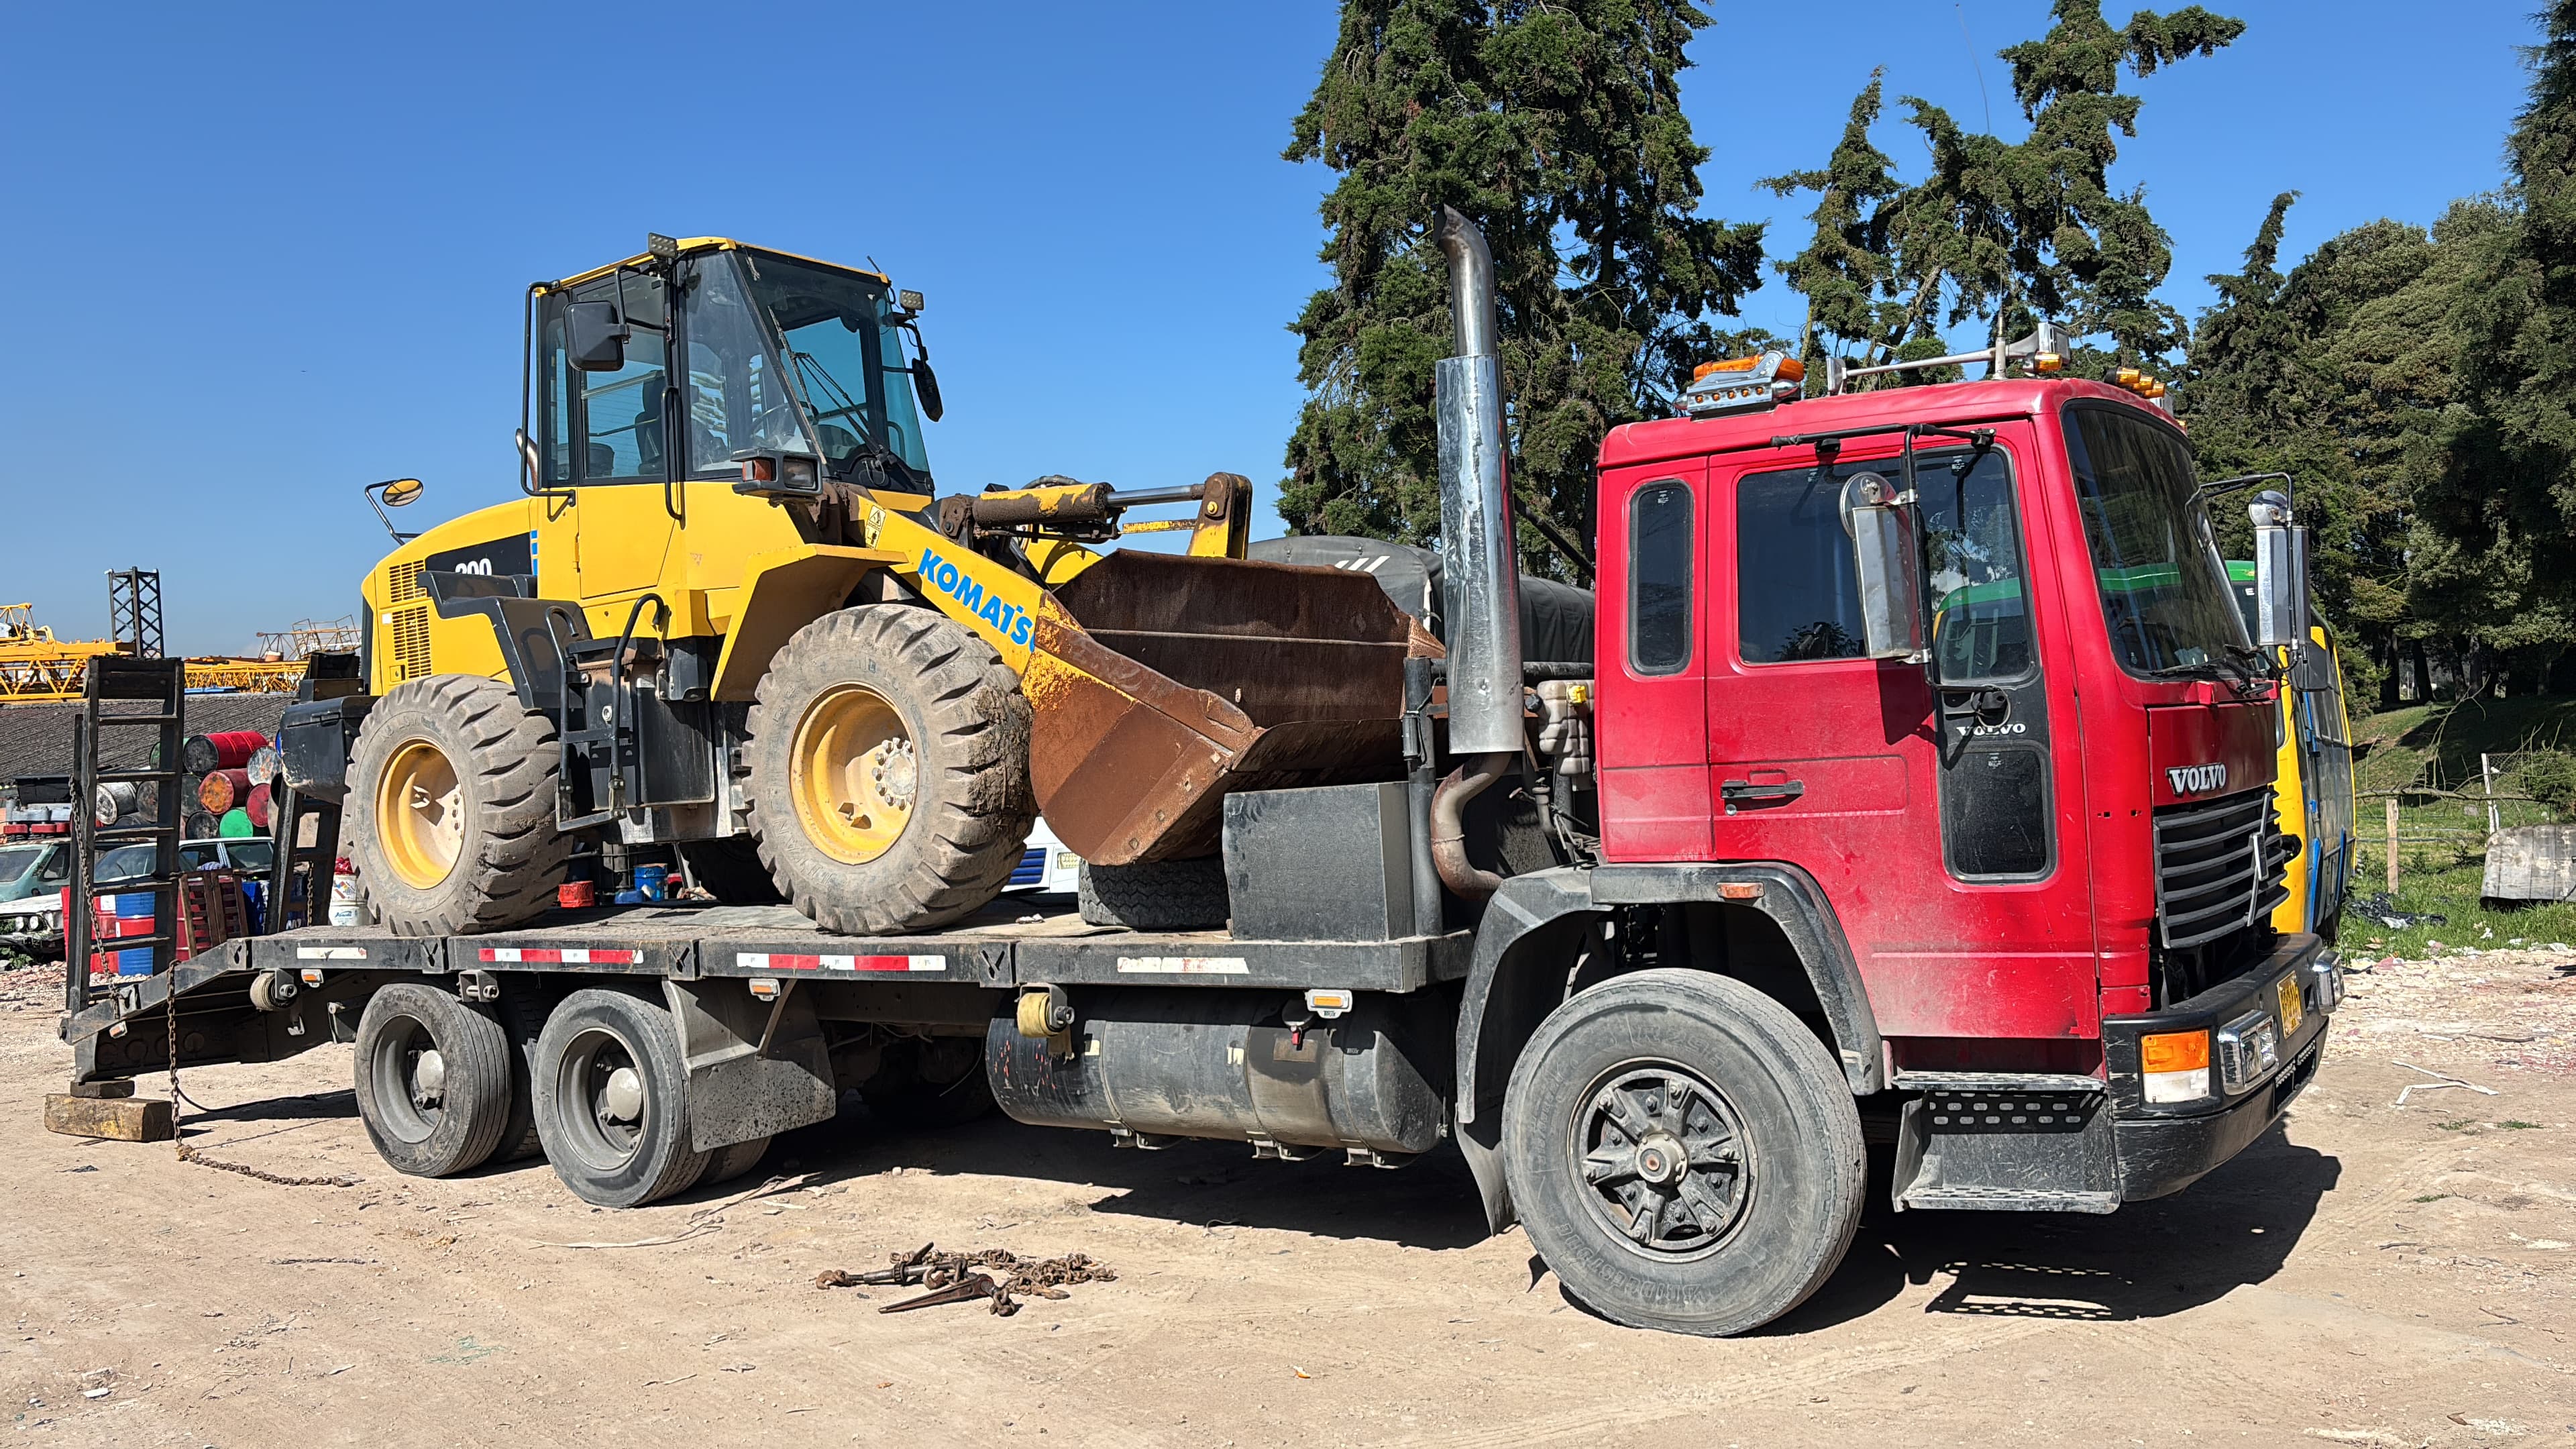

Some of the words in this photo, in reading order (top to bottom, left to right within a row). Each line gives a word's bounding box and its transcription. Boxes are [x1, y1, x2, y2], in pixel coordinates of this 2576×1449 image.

[918, 547, 1035, 653] KOMATS
[1956, 723, 2026, 736] VOLVO
[2168, 763, 2226, 793] VOLVO
